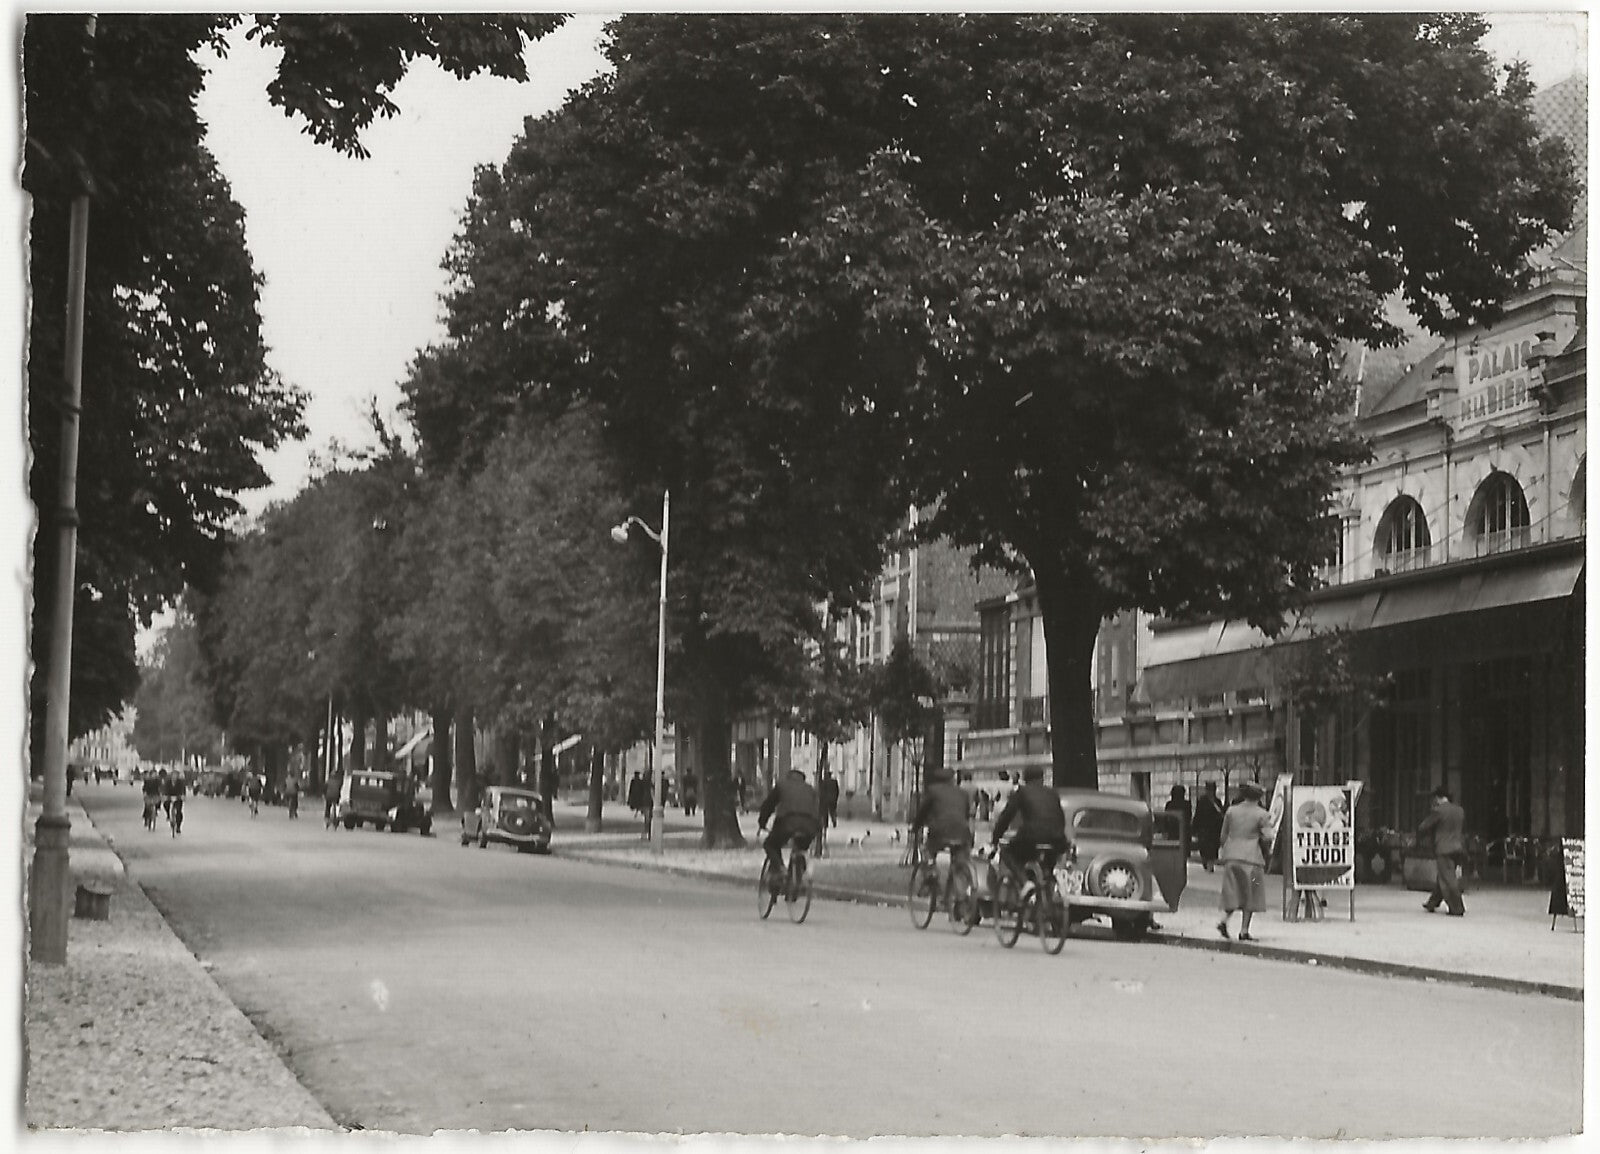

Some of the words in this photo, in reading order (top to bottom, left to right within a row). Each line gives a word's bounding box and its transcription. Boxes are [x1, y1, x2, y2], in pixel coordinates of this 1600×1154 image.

[1469, 340, 1531, 384] PALAIS
[1474, 395, 1485, 417] LA
[1488, 378, 1529, 414] BIER
[1297, 832, 1350, 847] TIRAGE
[1302, 848, 1346, 864] JEUDI
